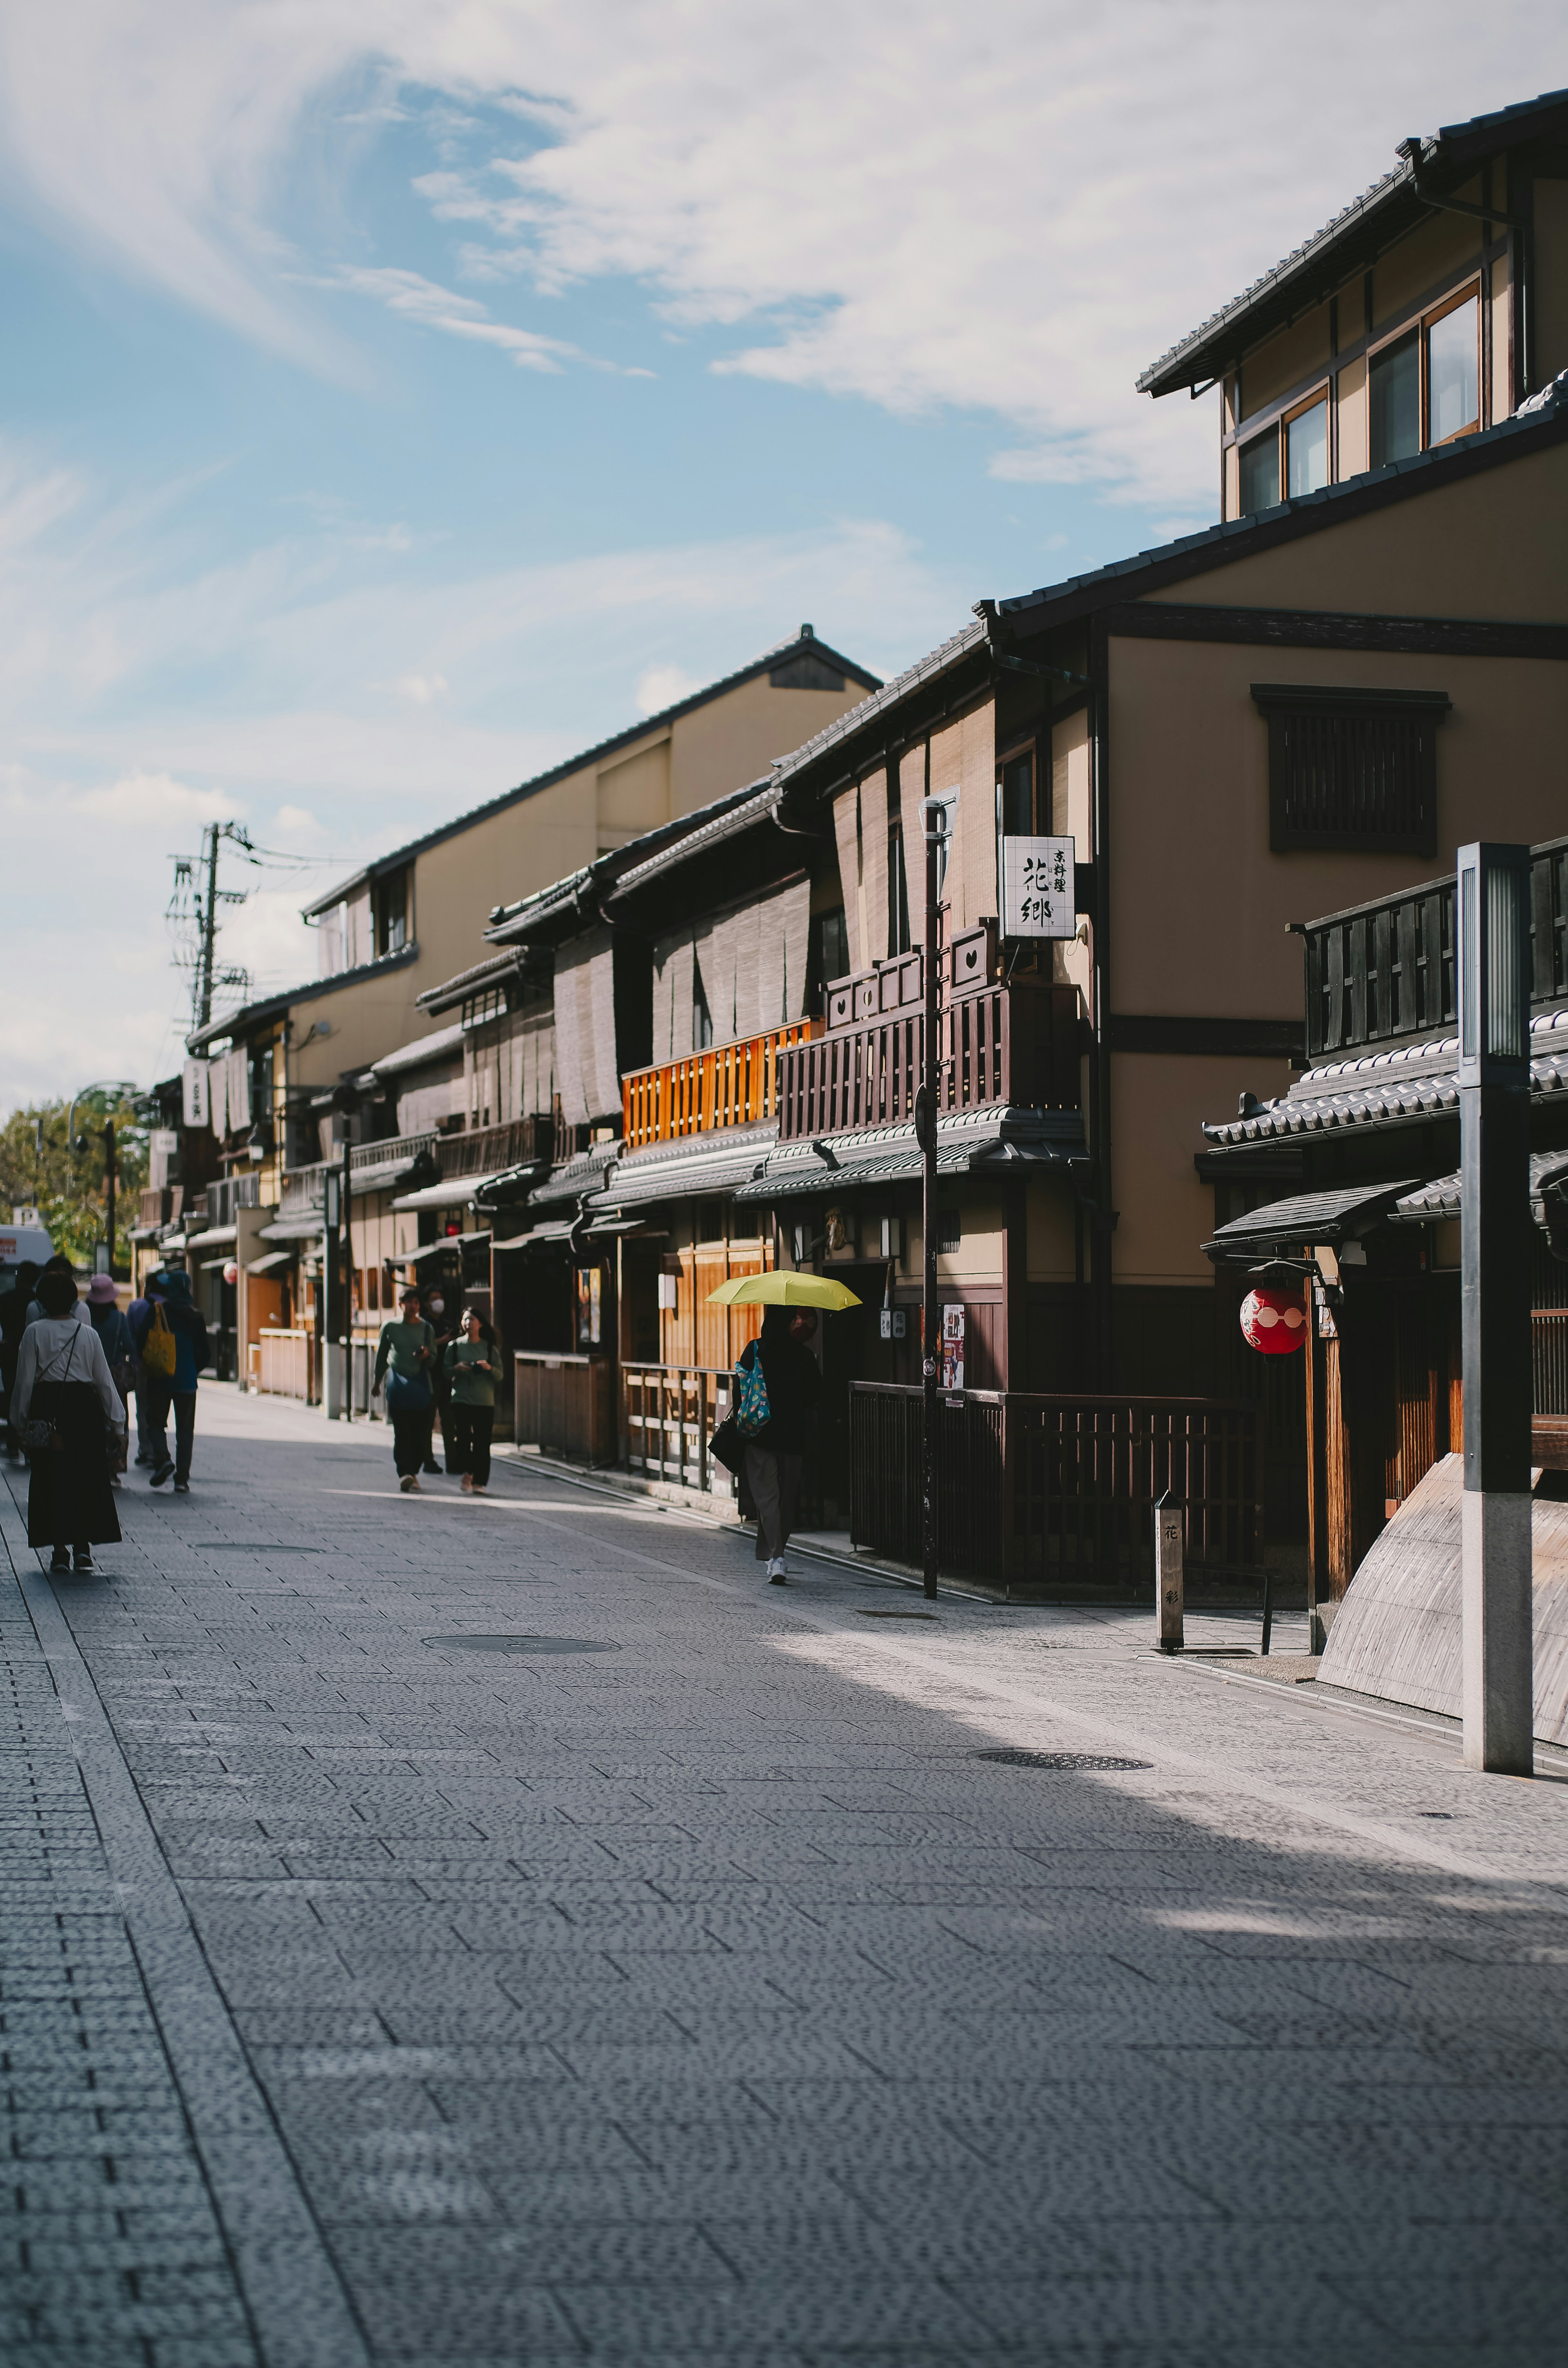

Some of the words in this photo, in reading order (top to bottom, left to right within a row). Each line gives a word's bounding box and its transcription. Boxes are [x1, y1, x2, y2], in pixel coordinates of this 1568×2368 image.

[1021, 857, 1051, 929] 花郷
[1054, 849, 1067, 892] 京料理
[1164, 1525, 1178, 1604] 花彩
